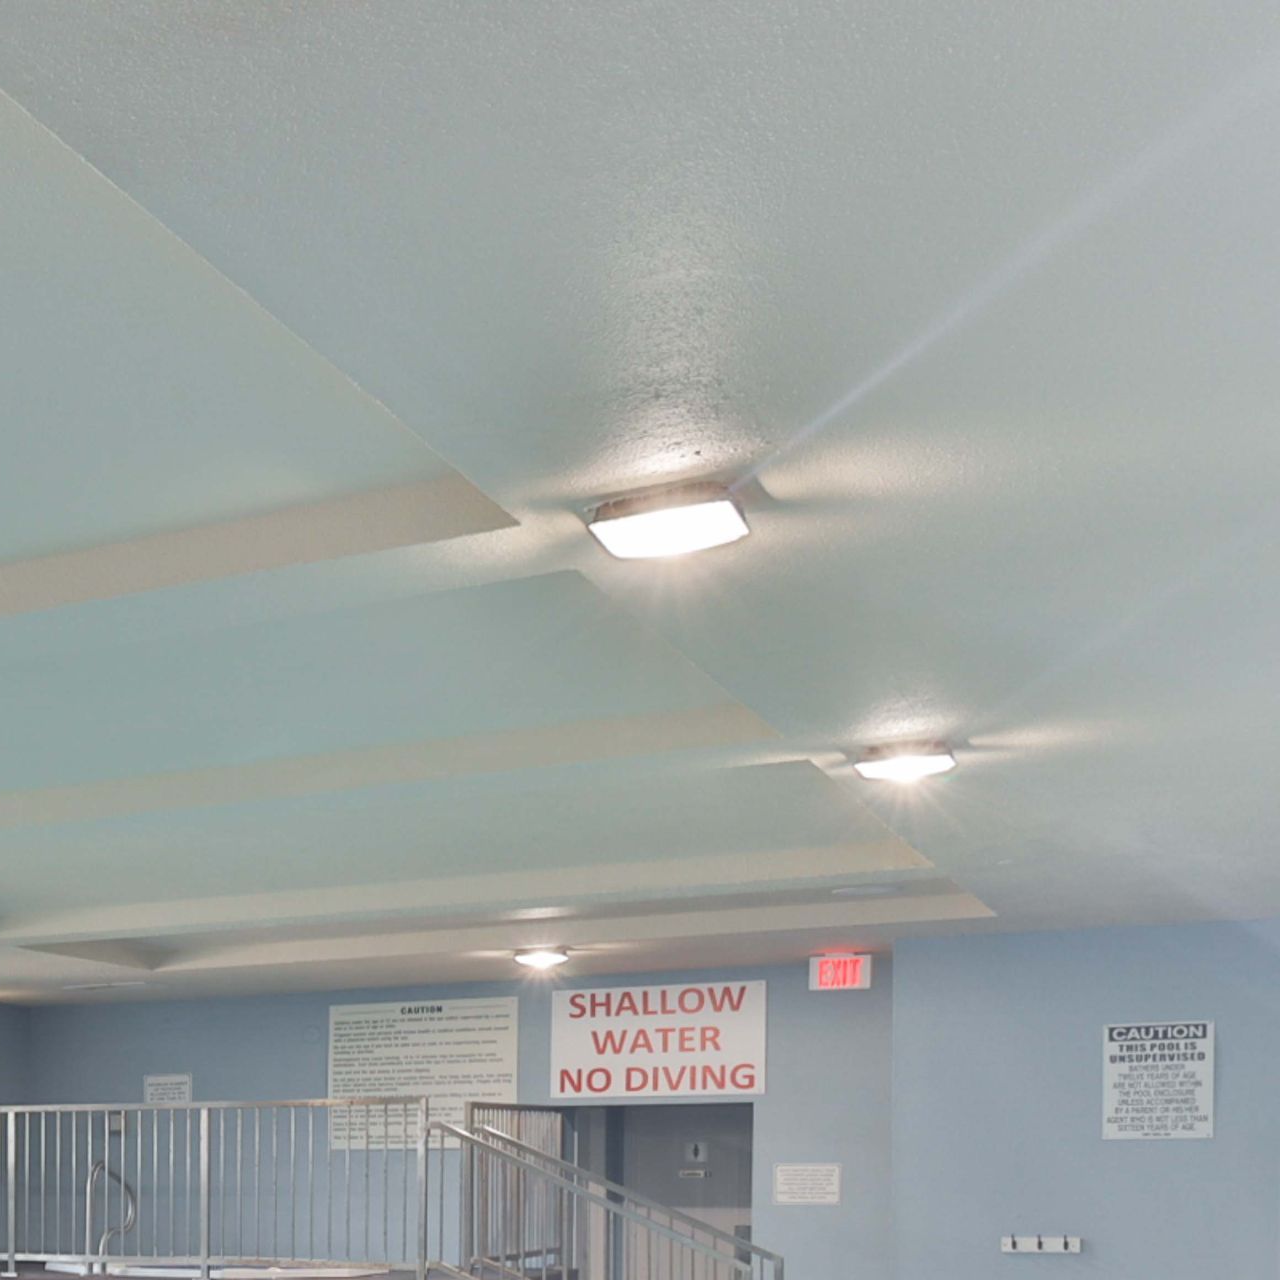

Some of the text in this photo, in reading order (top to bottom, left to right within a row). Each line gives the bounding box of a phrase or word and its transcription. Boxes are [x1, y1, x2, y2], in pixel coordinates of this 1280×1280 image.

[818, 957, 864, 987] EXIT
[400, 1005, 443, 1015] CAUTION
[569, 986, 746, 1018] SHALLOW
[591, 1026, 721, 1055] WATER
[1112, 1025, 1203, 1040] CAUTION
[1109, 1052, 1206, 1064] UNSUPERVISED
[1118, 1042, 1197, 1052] THIS POOL IS
[560, 1064, 755, 1093] NO DIVING
